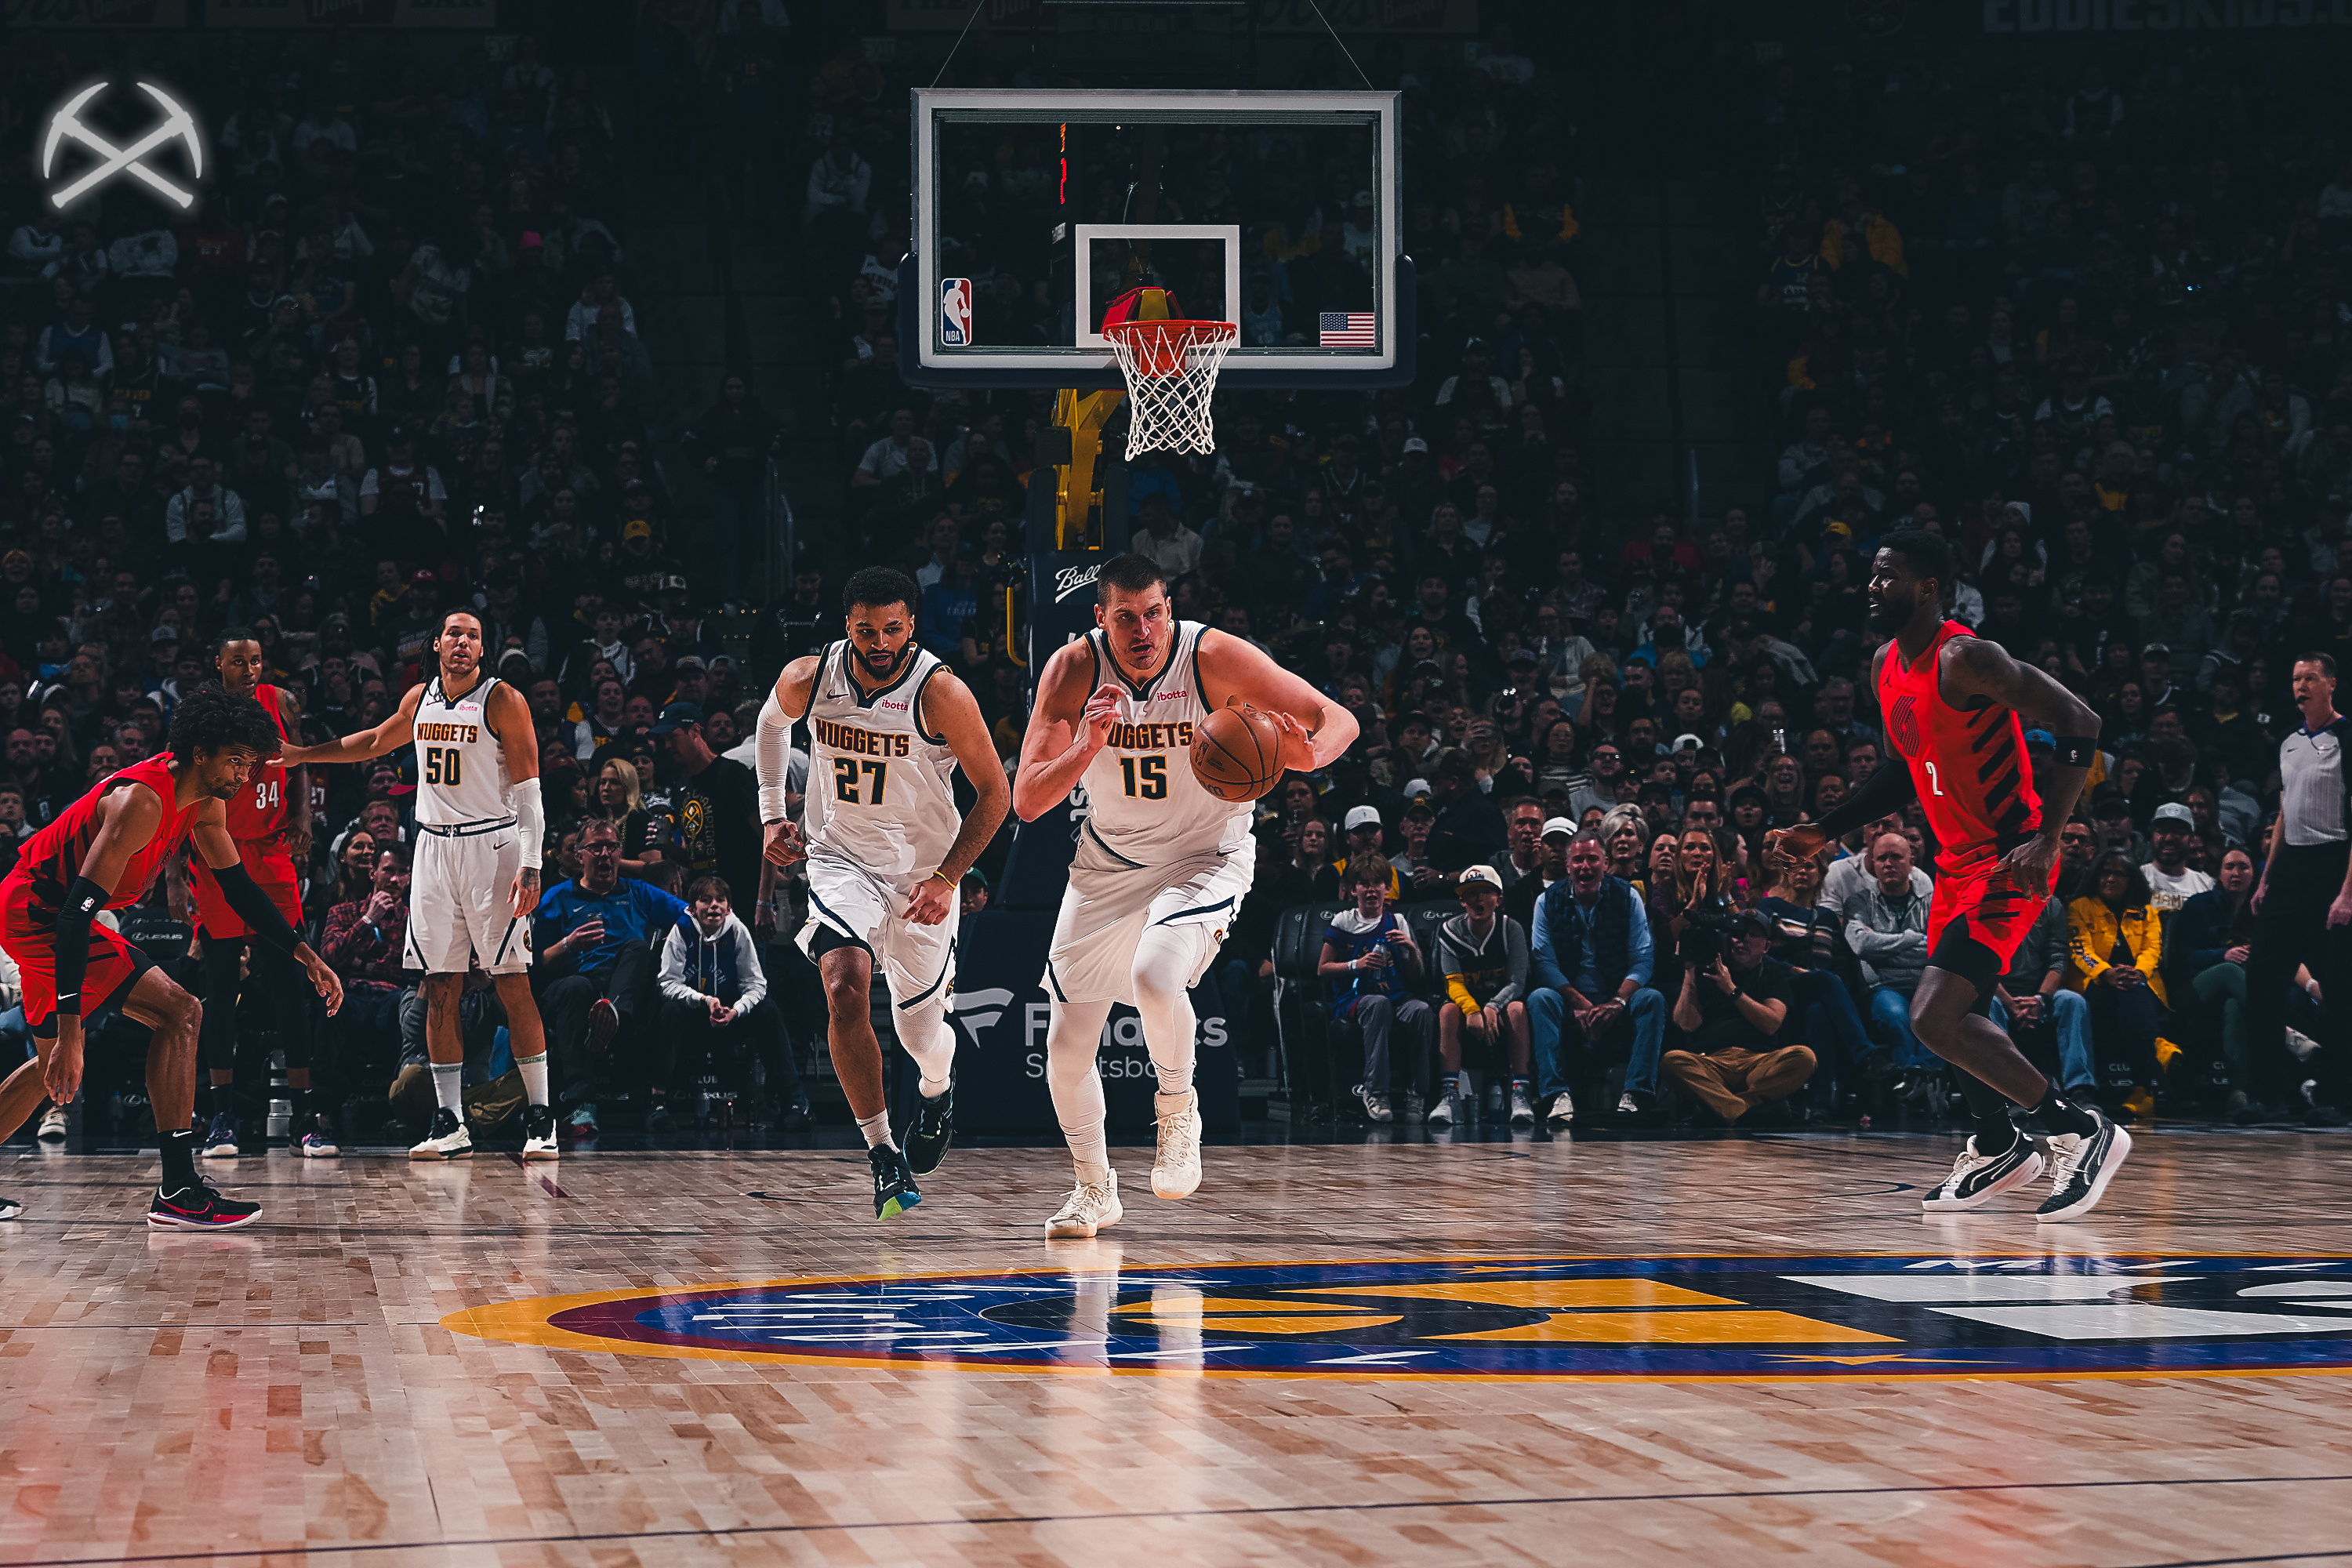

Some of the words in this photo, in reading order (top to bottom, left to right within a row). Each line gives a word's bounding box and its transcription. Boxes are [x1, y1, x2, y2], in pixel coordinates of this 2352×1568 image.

[946, 332, 960, 342] NBA
[1054, 564, 1102, 592] Ball
[881, 698, 908, 711] ibotta
[1156, 690, 1188, 702] ibotta
[416, 722, 478, 744] NUGGETS
[815, 717, 909, 758] NUGGETS
[1106, 720, 1193, 750] UGGETS
[426, 746, 461, 787] 50
[833, 757, 887, 806] 27
[1119, 753, 1168, 800] 15
[1925, 760, 1944, 797] 2
[255, 780, 280, 810] 34
